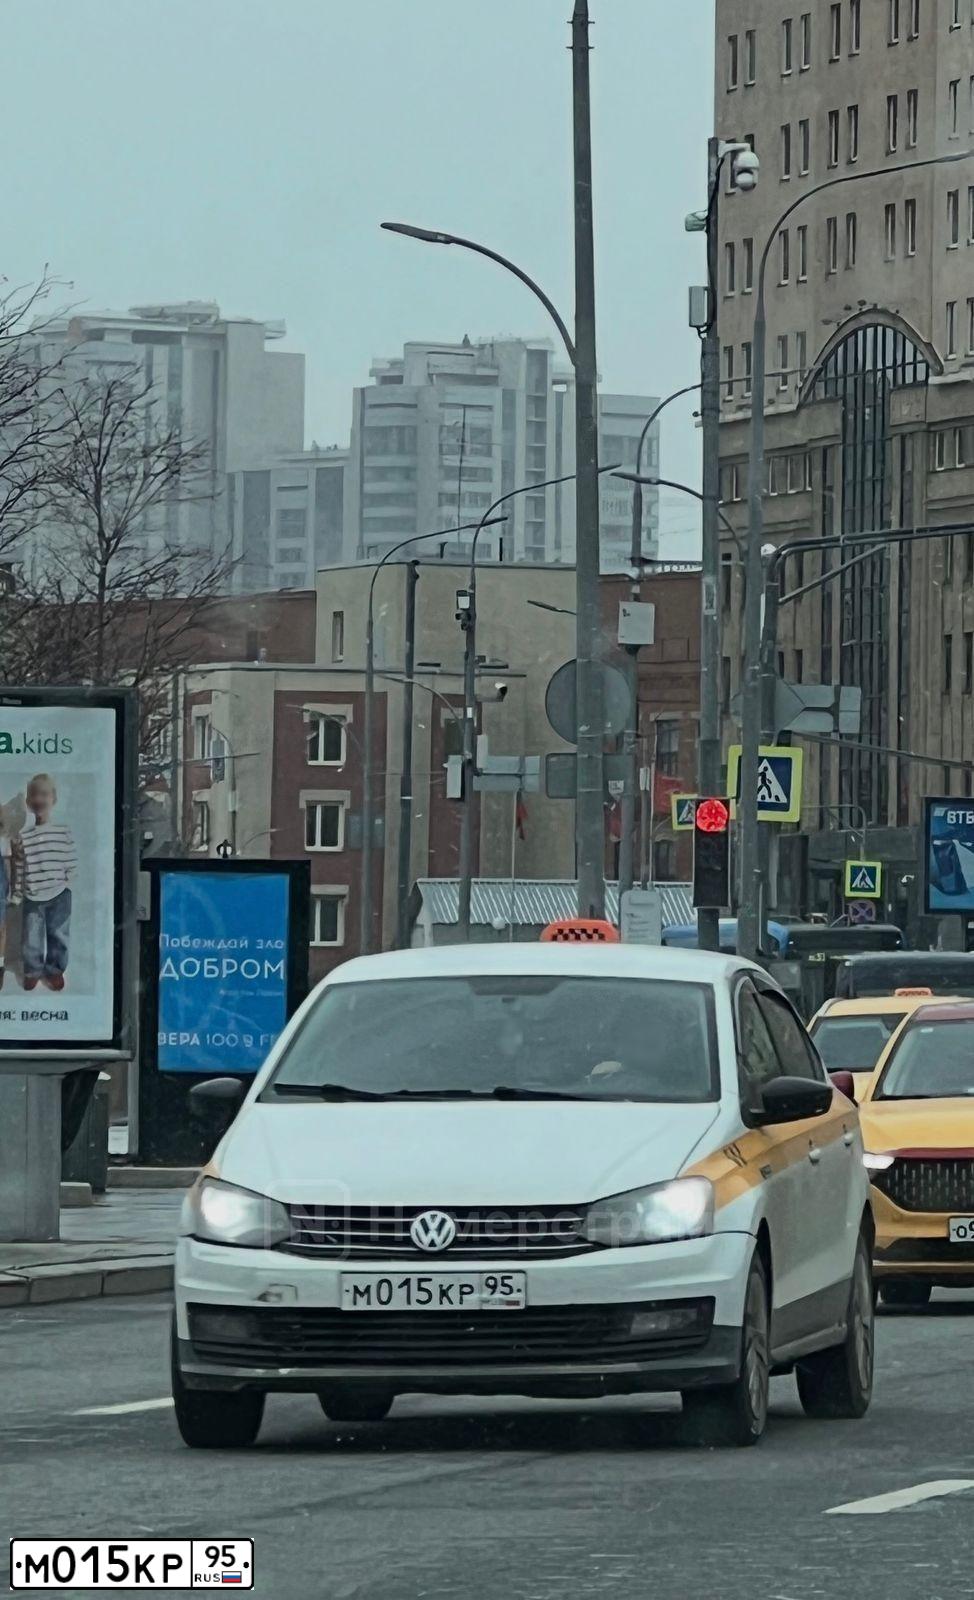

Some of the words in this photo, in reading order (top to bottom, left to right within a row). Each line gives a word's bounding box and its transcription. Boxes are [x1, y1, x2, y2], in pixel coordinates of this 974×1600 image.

[159, 934, 248, 949] Побеждай
[256, 939, 285, 949] зло
[159, 957, 285, 981] ДОБРОМ
[158, 1032, 200, 1046] ВЕРА
[352, 1277, 475, 1306] М015КР
[484, 1275, 514, 1296] 95
